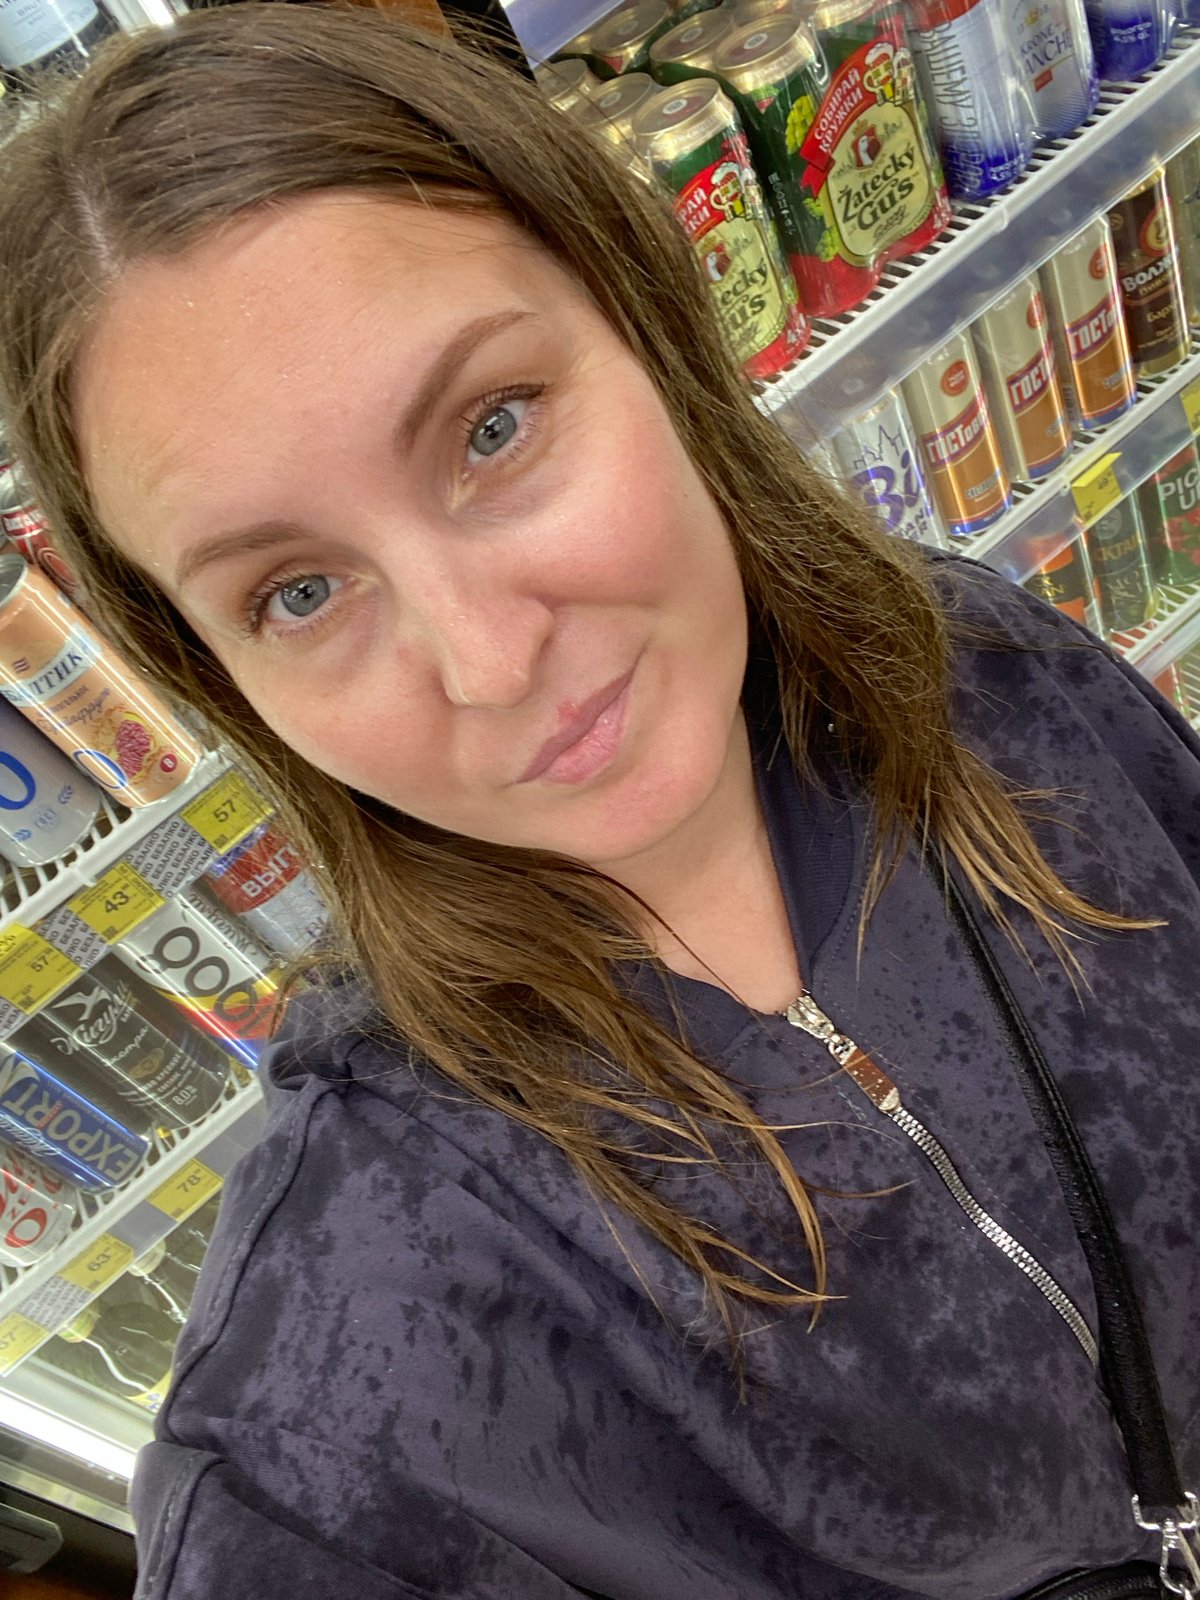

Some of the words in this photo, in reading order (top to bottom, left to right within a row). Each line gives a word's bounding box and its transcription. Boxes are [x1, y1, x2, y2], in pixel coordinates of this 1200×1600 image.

[814, 67, 861, 140] СОБИРАЙ
[819, 87, 864, 153] КРУЖКИ
[837, 142, 915, 224] Žatecký
[213, 799, 238, 823] 57
[151, 840, 180, 880] БЕЗАЛКО
[154, 820, 180, 861] БЕЗАЛКО
[172, 850, 200, 888] БЕЗАЛКО
[104, 890, 130, 915] 43
[30, 955, 50, 973] 57
[5, 1082, 139, 1182] EXPORT
